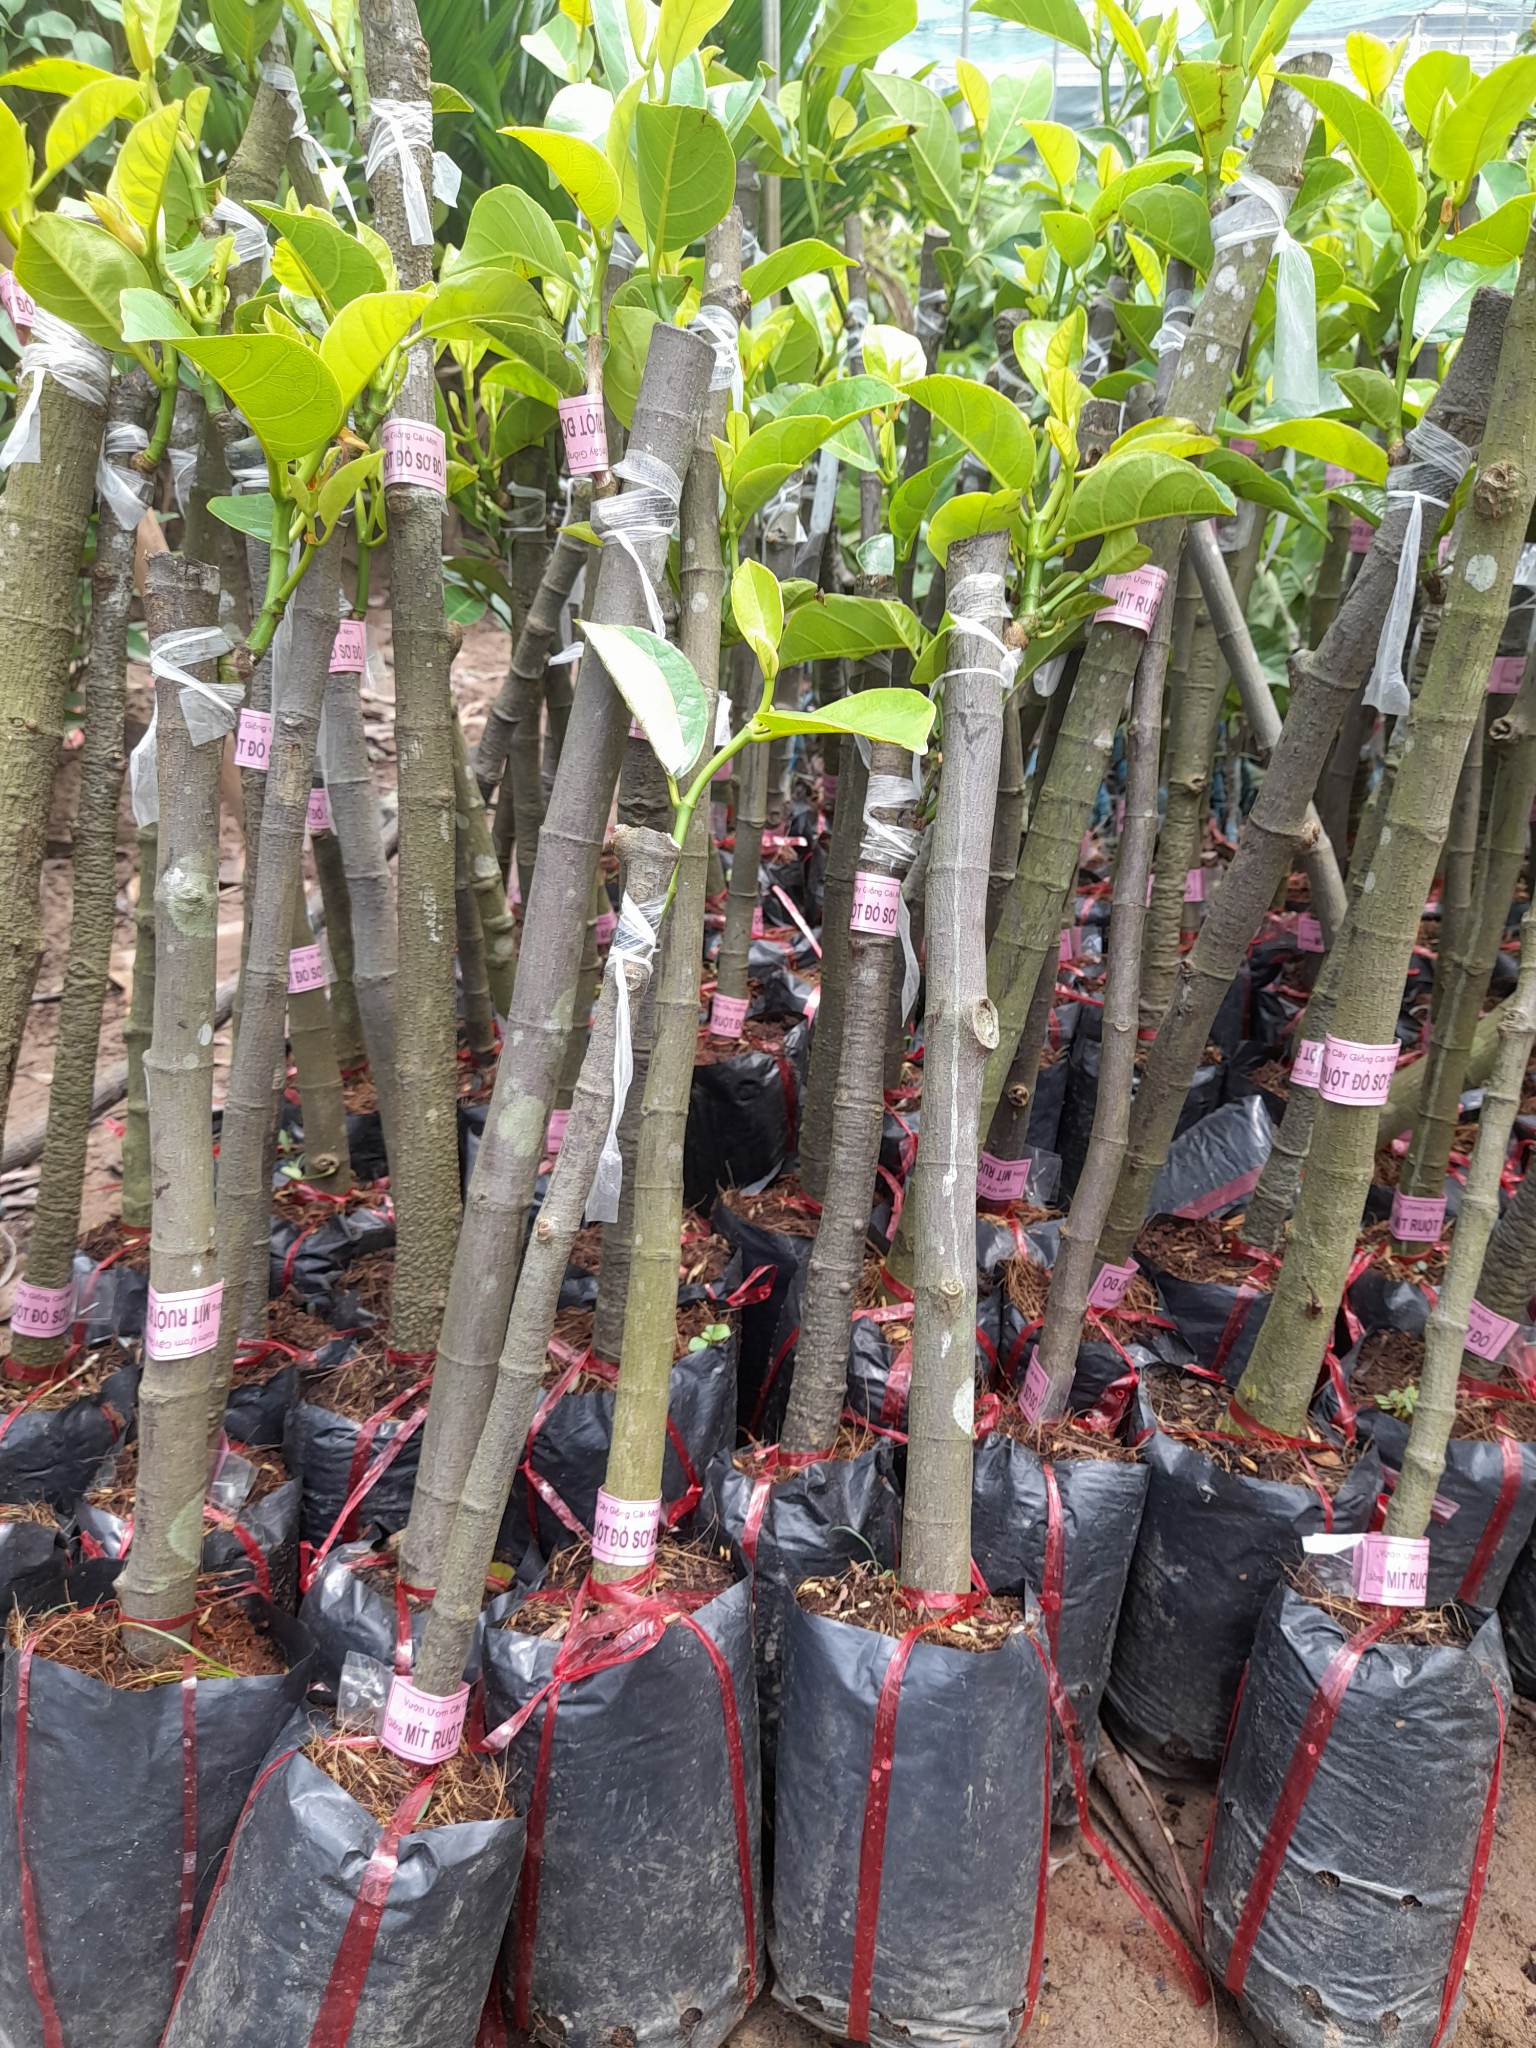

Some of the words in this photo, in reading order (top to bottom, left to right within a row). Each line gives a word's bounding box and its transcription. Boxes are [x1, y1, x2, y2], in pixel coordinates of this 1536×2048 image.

[396, 445, 413, 468] ĐỎ
[416, 451, 431, 472] SƠ
[865, 901, 881, 923] ĐỎ
[882, 907, 897, 925] SƠ
[1351, 1069, 1371, 1092] ĐỎ
[31, 1305, 49, 1325] ĐỎ
[610, 1525, 629, 1549] ĐỎ
[632, 1529, 650, 1549] SƠ
[404, 1721, 431, 1749] MÍT
[431, 1720, 462, 1752] RUỘT
